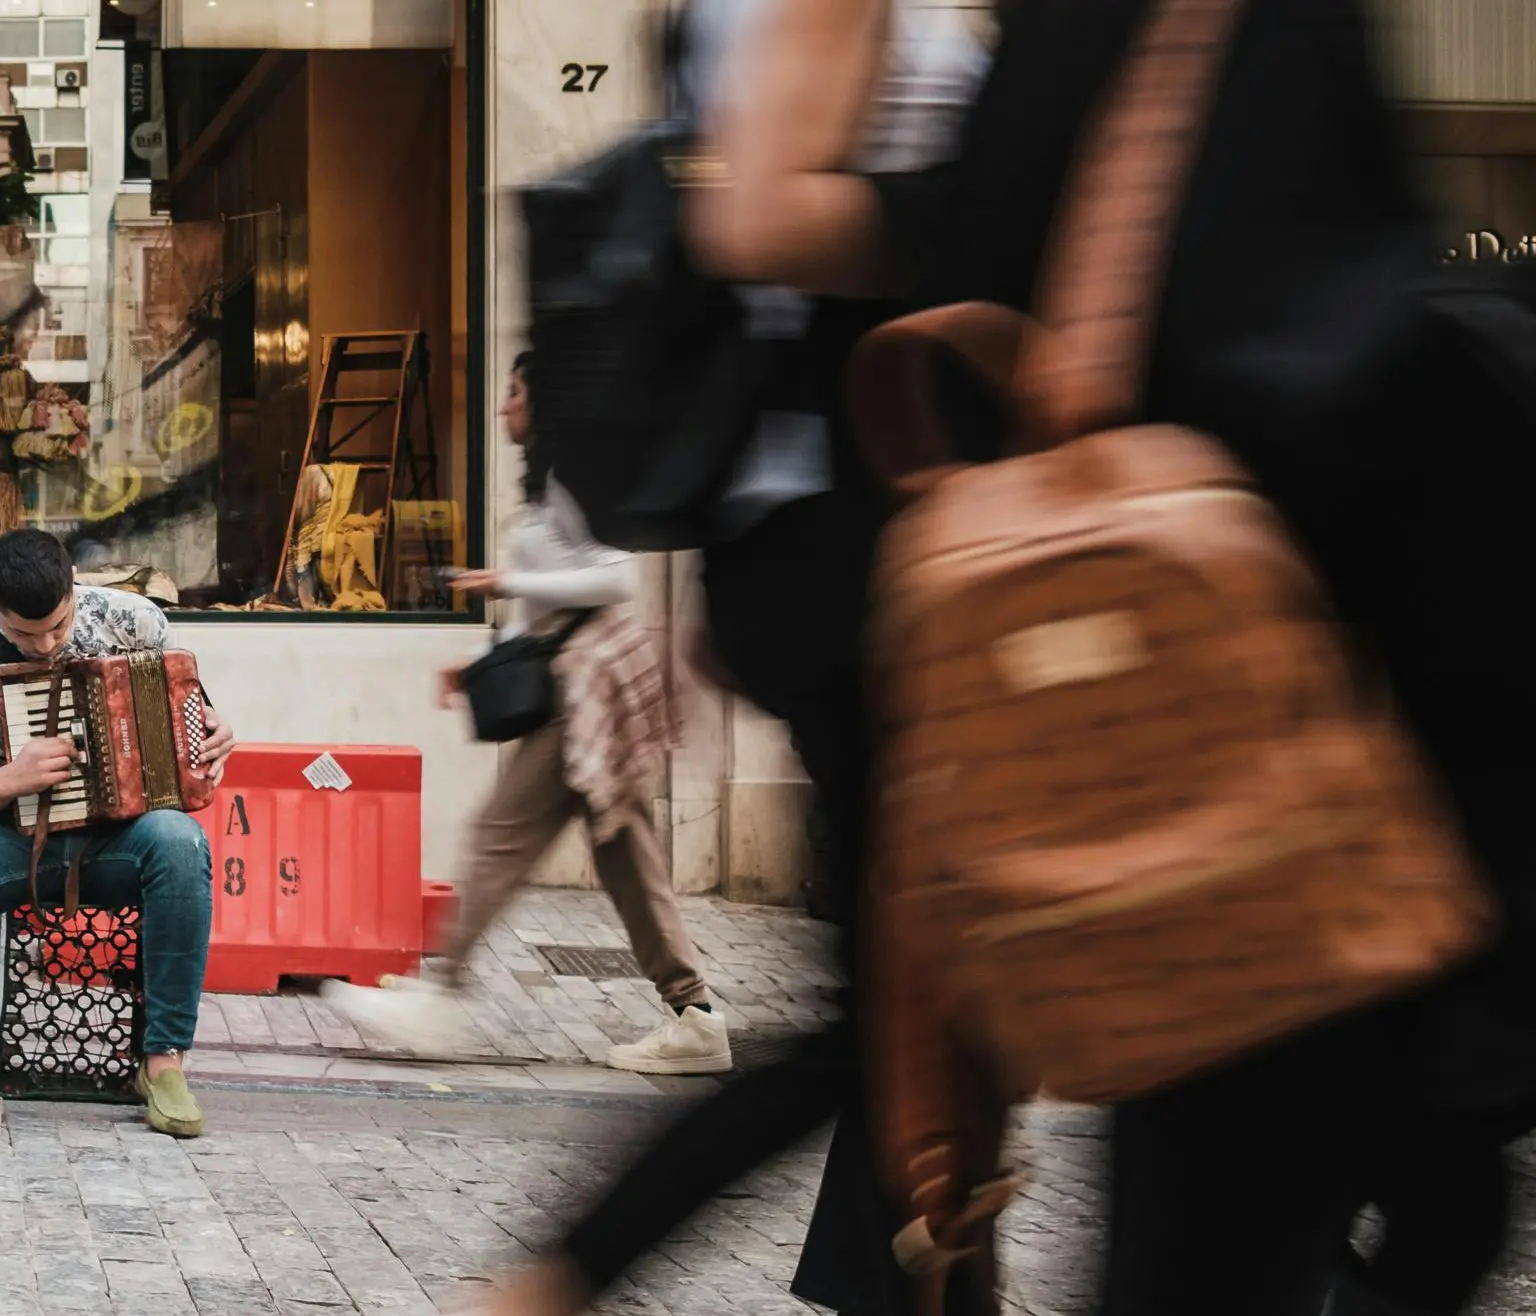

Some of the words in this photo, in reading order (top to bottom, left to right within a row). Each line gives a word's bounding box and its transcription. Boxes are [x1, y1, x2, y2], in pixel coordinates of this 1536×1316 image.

[561, 63, 609, 92] 27
[226, 795, 251, 836] A
[224, 857, 246, 896] 8
